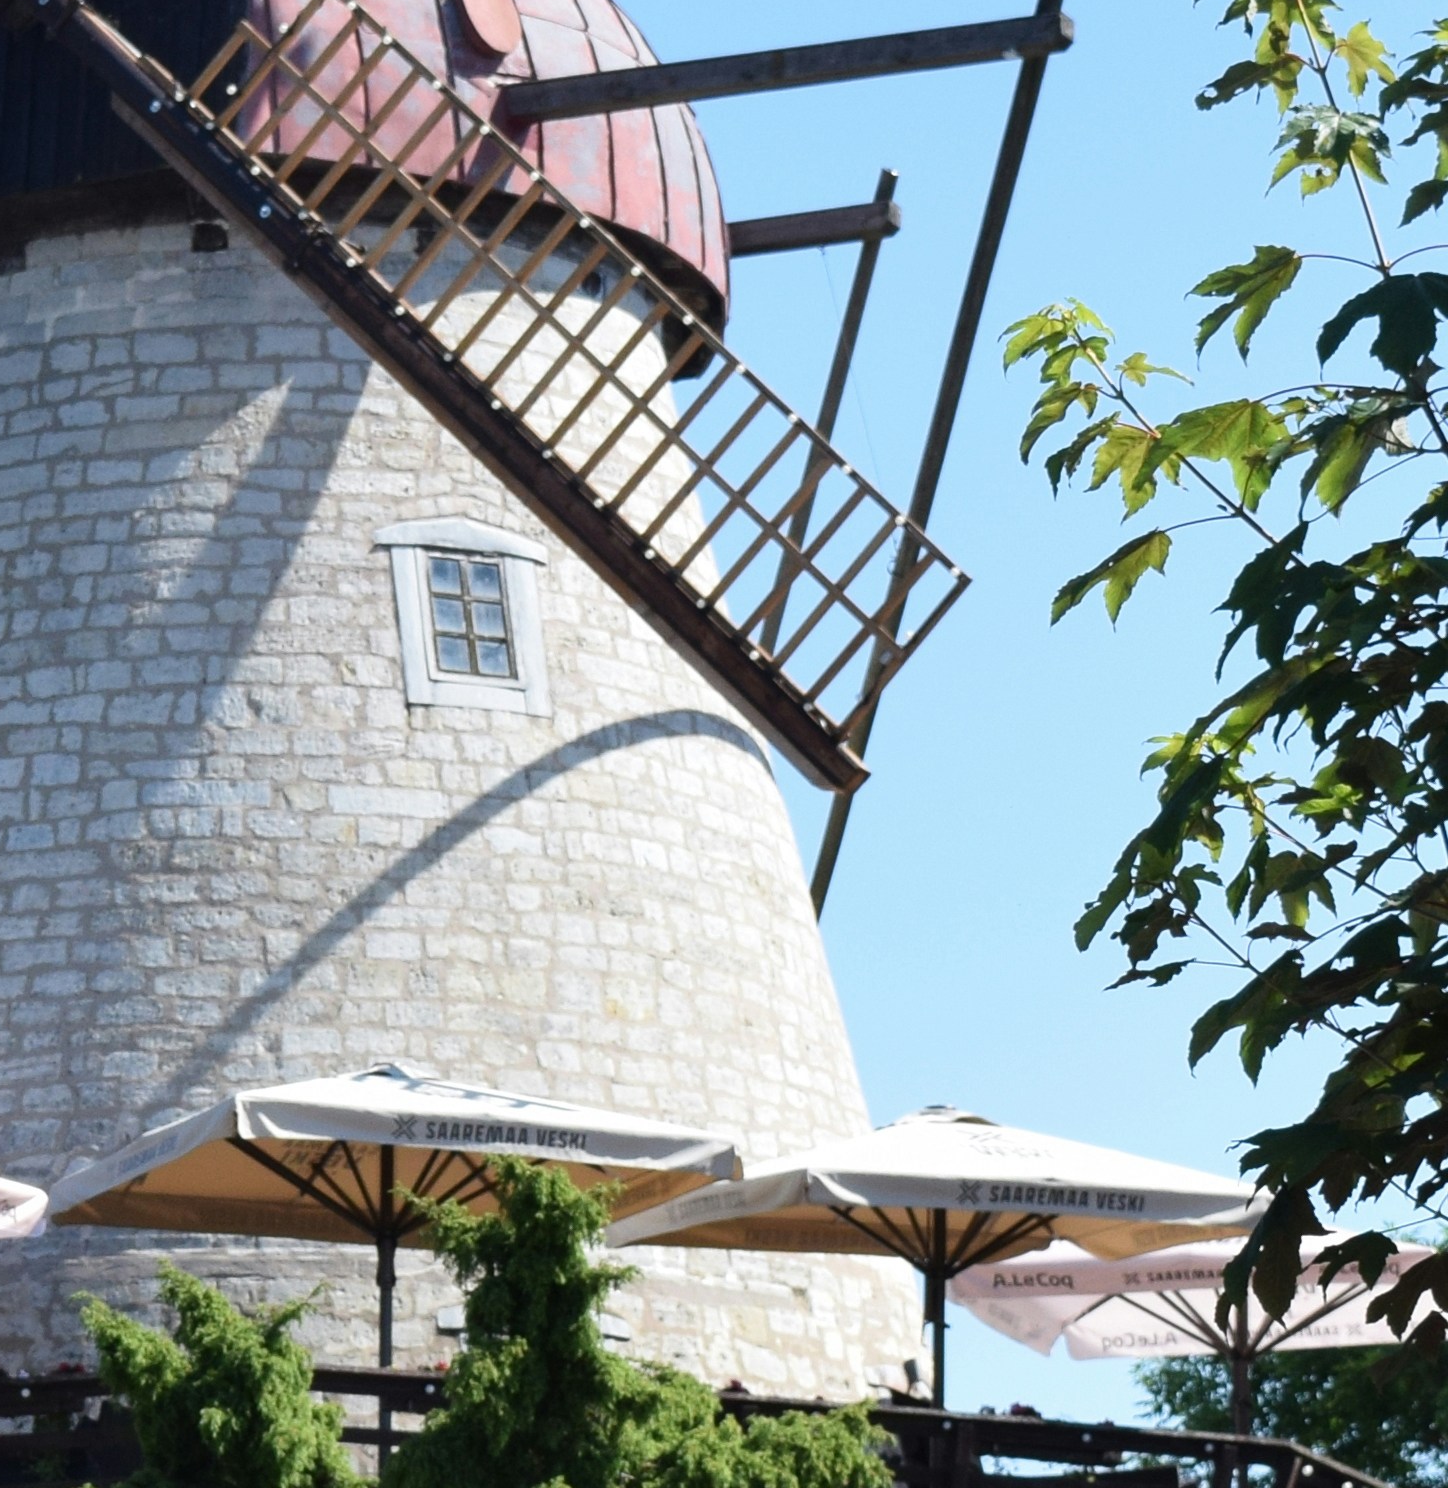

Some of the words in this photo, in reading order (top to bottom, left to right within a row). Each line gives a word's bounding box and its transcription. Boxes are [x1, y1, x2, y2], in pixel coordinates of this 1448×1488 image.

[424, 1120, 529, 1145] SAAREMAA
[536, 1127, 588, 1151] VESKI
[988, 1184, 1089, 1209] SAAREMAA
[1096, 1192, 1146, 1213] VESKI
[992, 1271, 1076, 1290] A.LeCoq
